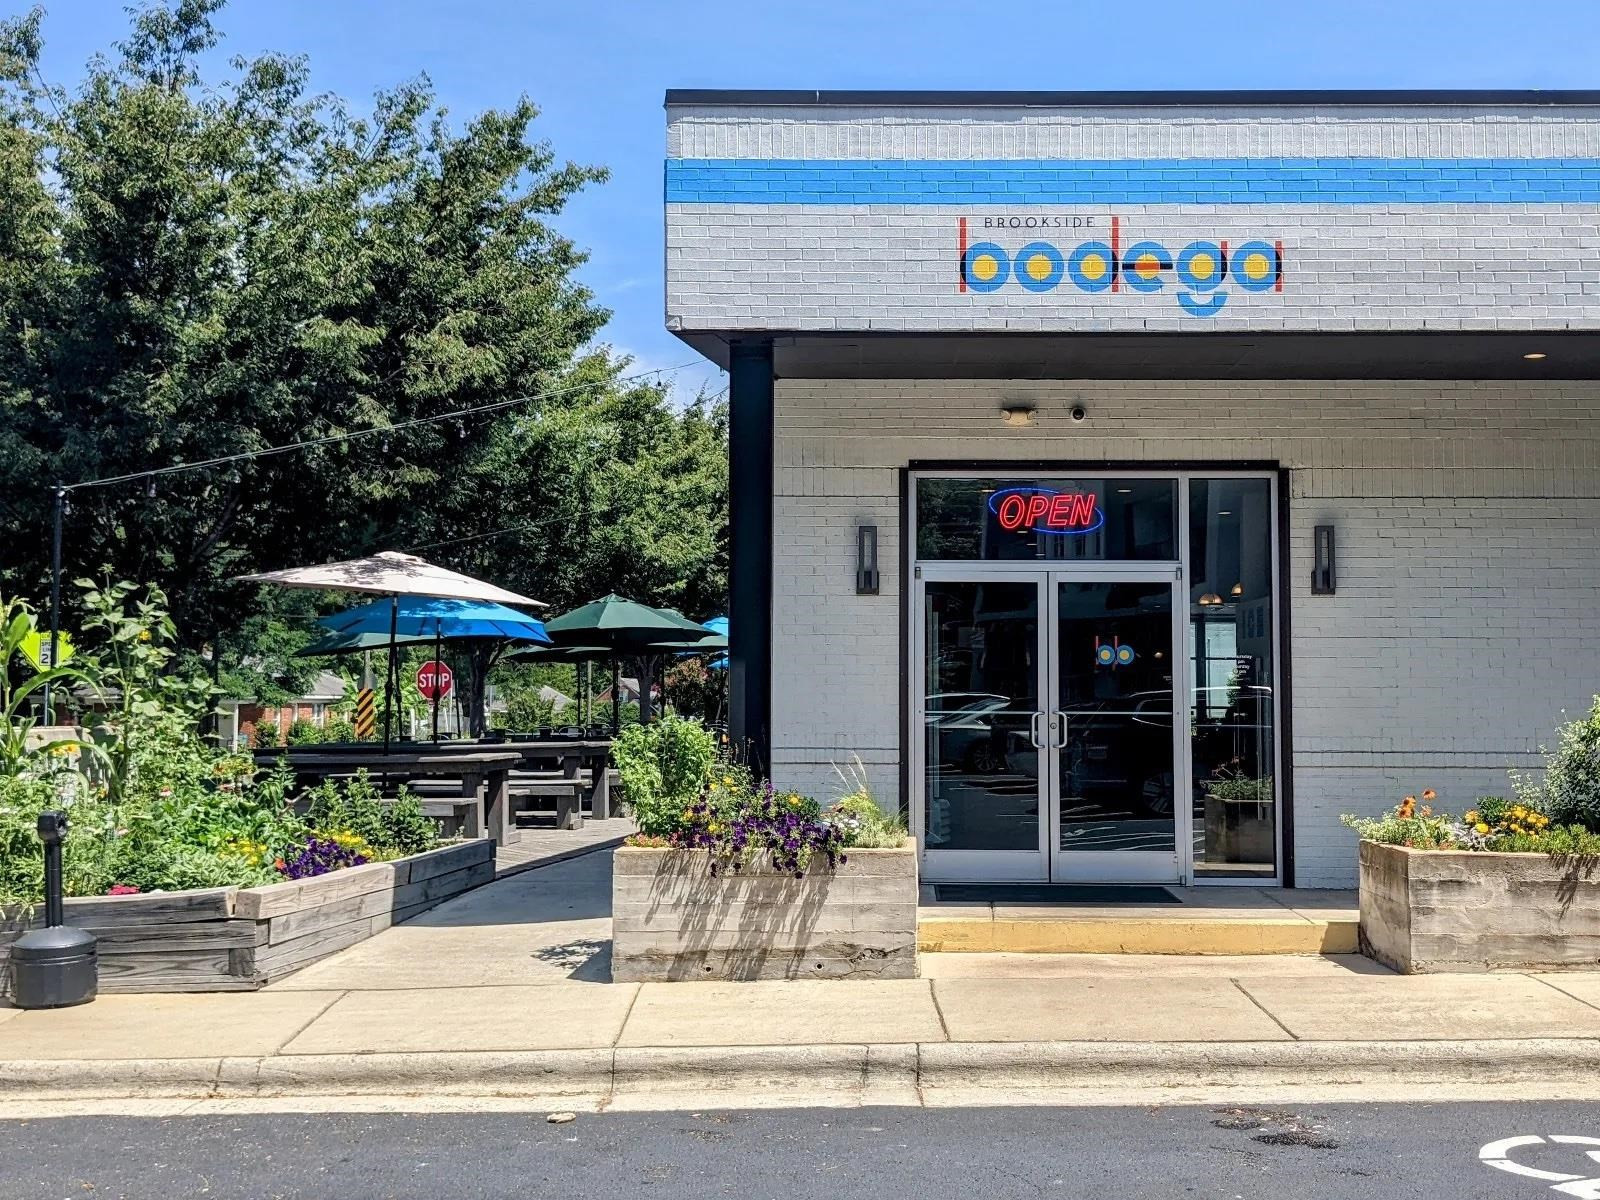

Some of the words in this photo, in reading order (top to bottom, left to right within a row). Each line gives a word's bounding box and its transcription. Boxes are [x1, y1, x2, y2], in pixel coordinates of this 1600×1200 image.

[984, 217, 1095, 228] BROOKSIDE
[959, 216, 1283, 317] bodega
[1000, 495, 1095, 528] OPEN
[41, 653, 48, 664] 2
[419, 673, 450, 688] STOP
